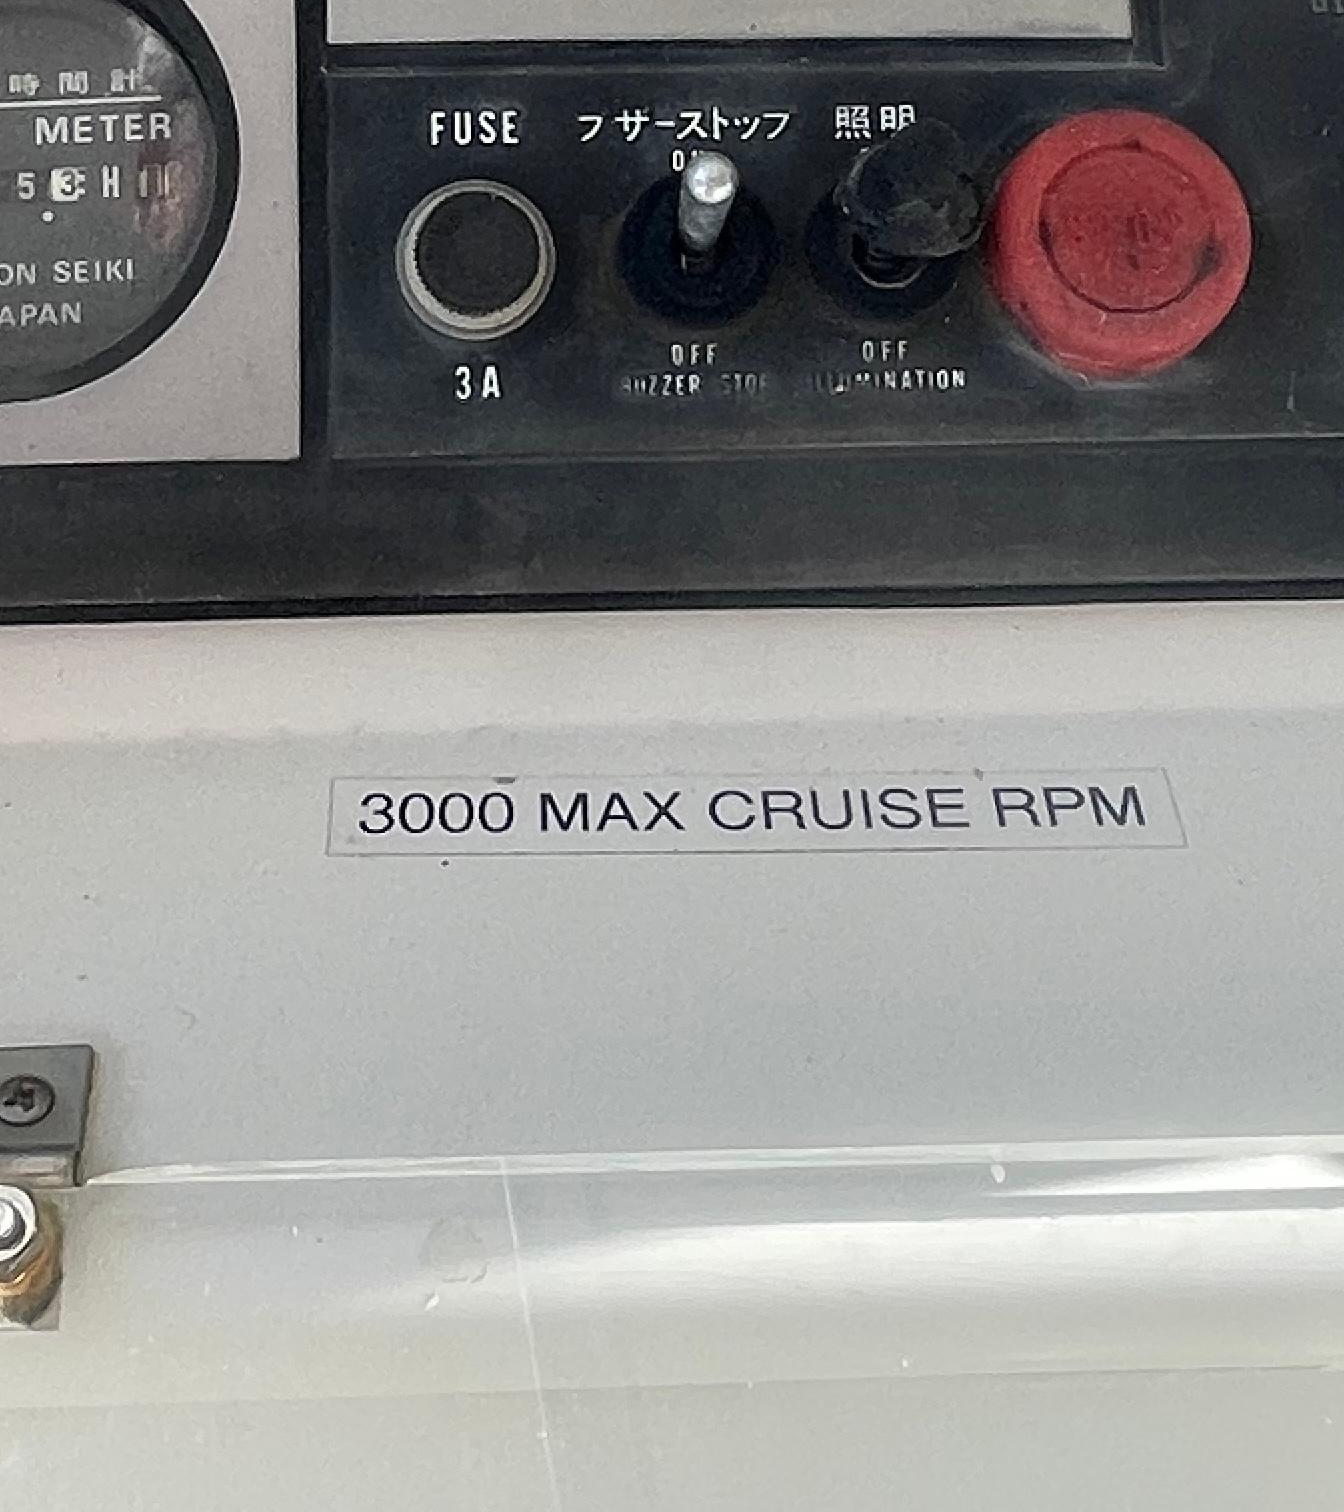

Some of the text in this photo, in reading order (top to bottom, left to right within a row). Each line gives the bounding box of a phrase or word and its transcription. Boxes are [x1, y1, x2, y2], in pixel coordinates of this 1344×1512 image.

[35, 112, 172, 146] METER
[430, 110, 519, 145] FUSE
[835, 104, 916, 139] 照明
[53, 259, 134, 282] SEIKI
[670, 343, 718, 366] OFF
[862, 339, 908, 363] OFF
[359, 785, 1148, 836] 3000 MAX CRUISE RPM
